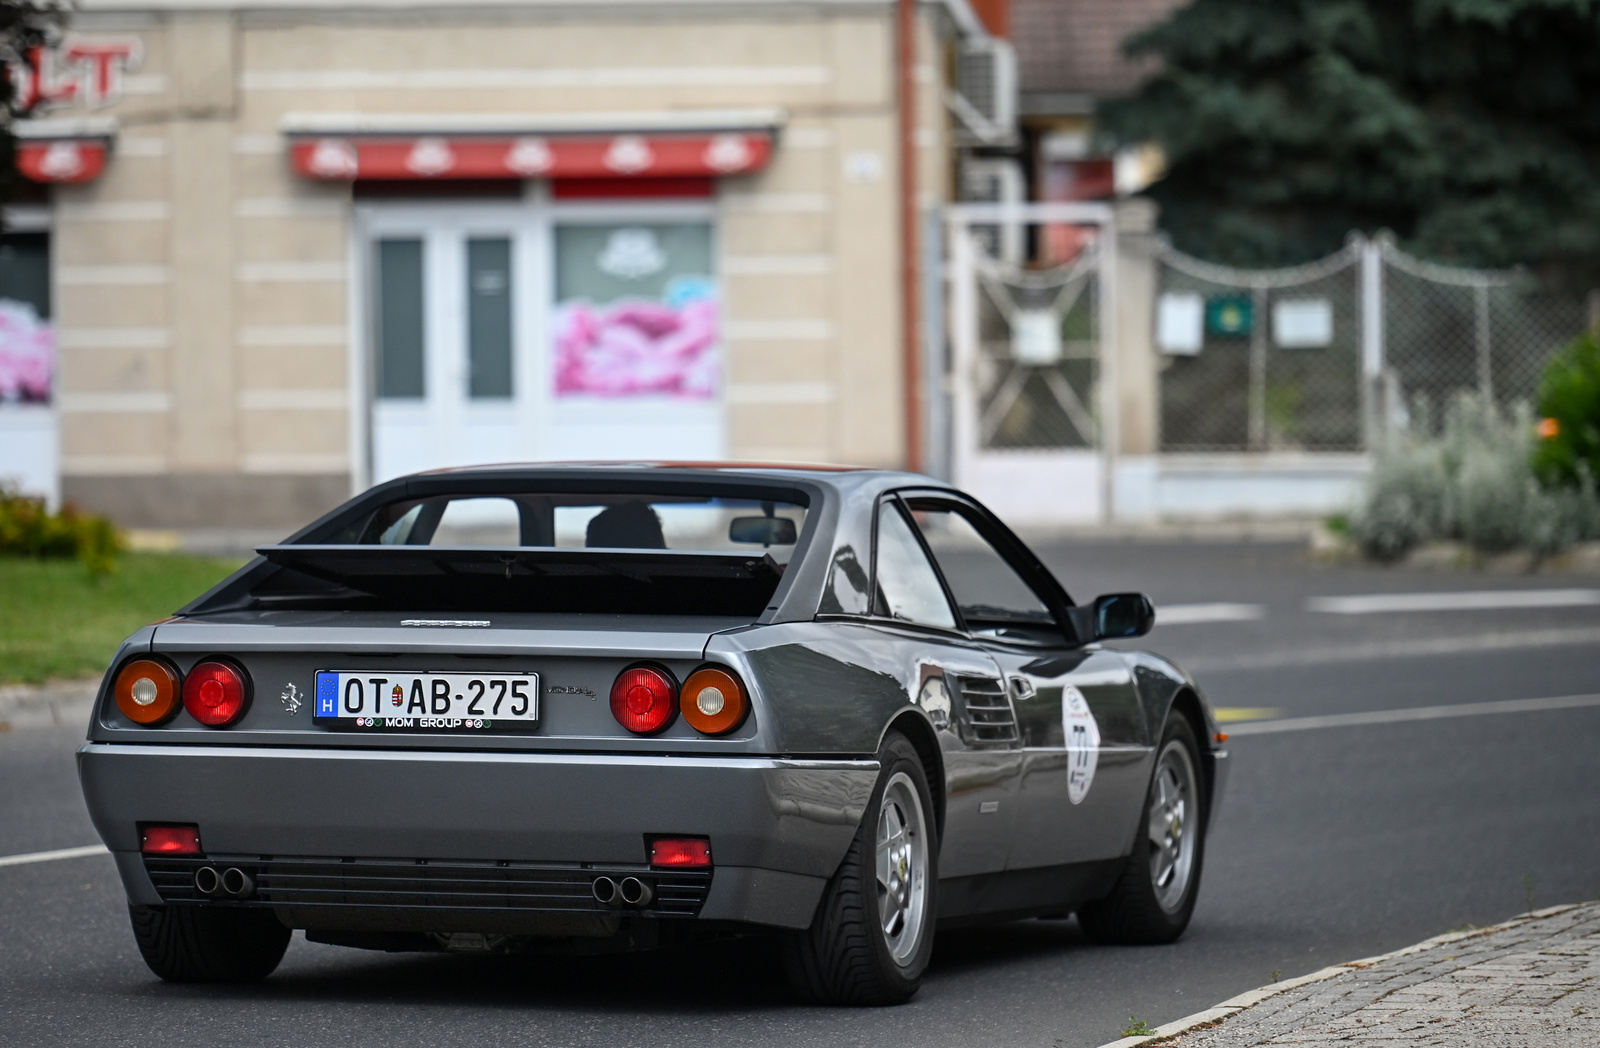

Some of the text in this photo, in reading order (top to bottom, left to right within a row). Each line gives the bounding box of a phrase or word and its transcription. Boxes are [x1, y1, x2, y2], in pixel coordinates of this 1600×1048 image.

[322, 699, 333, 712] H
[385, 717, 462, 729] MOM GROUP
